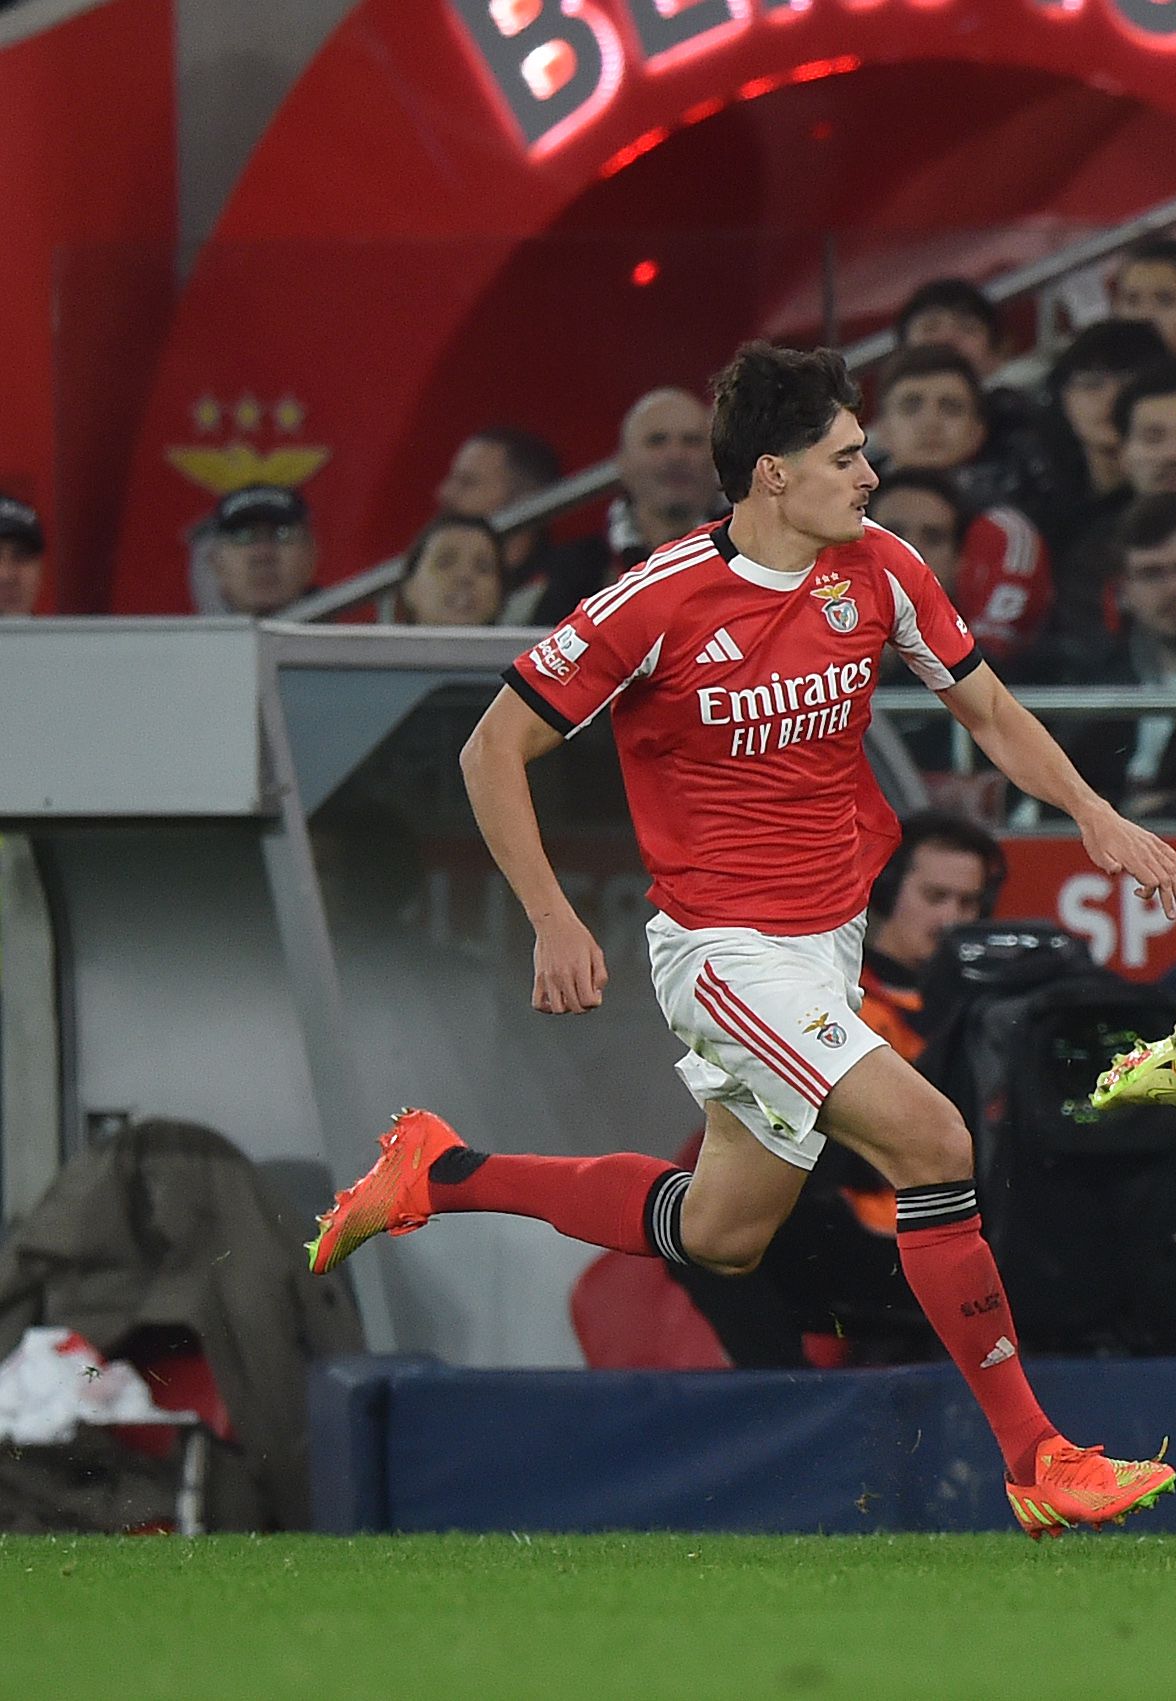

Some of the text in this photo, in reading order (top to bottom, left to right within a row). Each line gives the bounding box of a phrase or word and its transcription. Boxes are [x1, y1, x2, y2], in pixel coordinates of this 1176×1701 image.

[696, 656, 873, 726] Emirates
[730, 699, 852, 757] FLY BETTER
